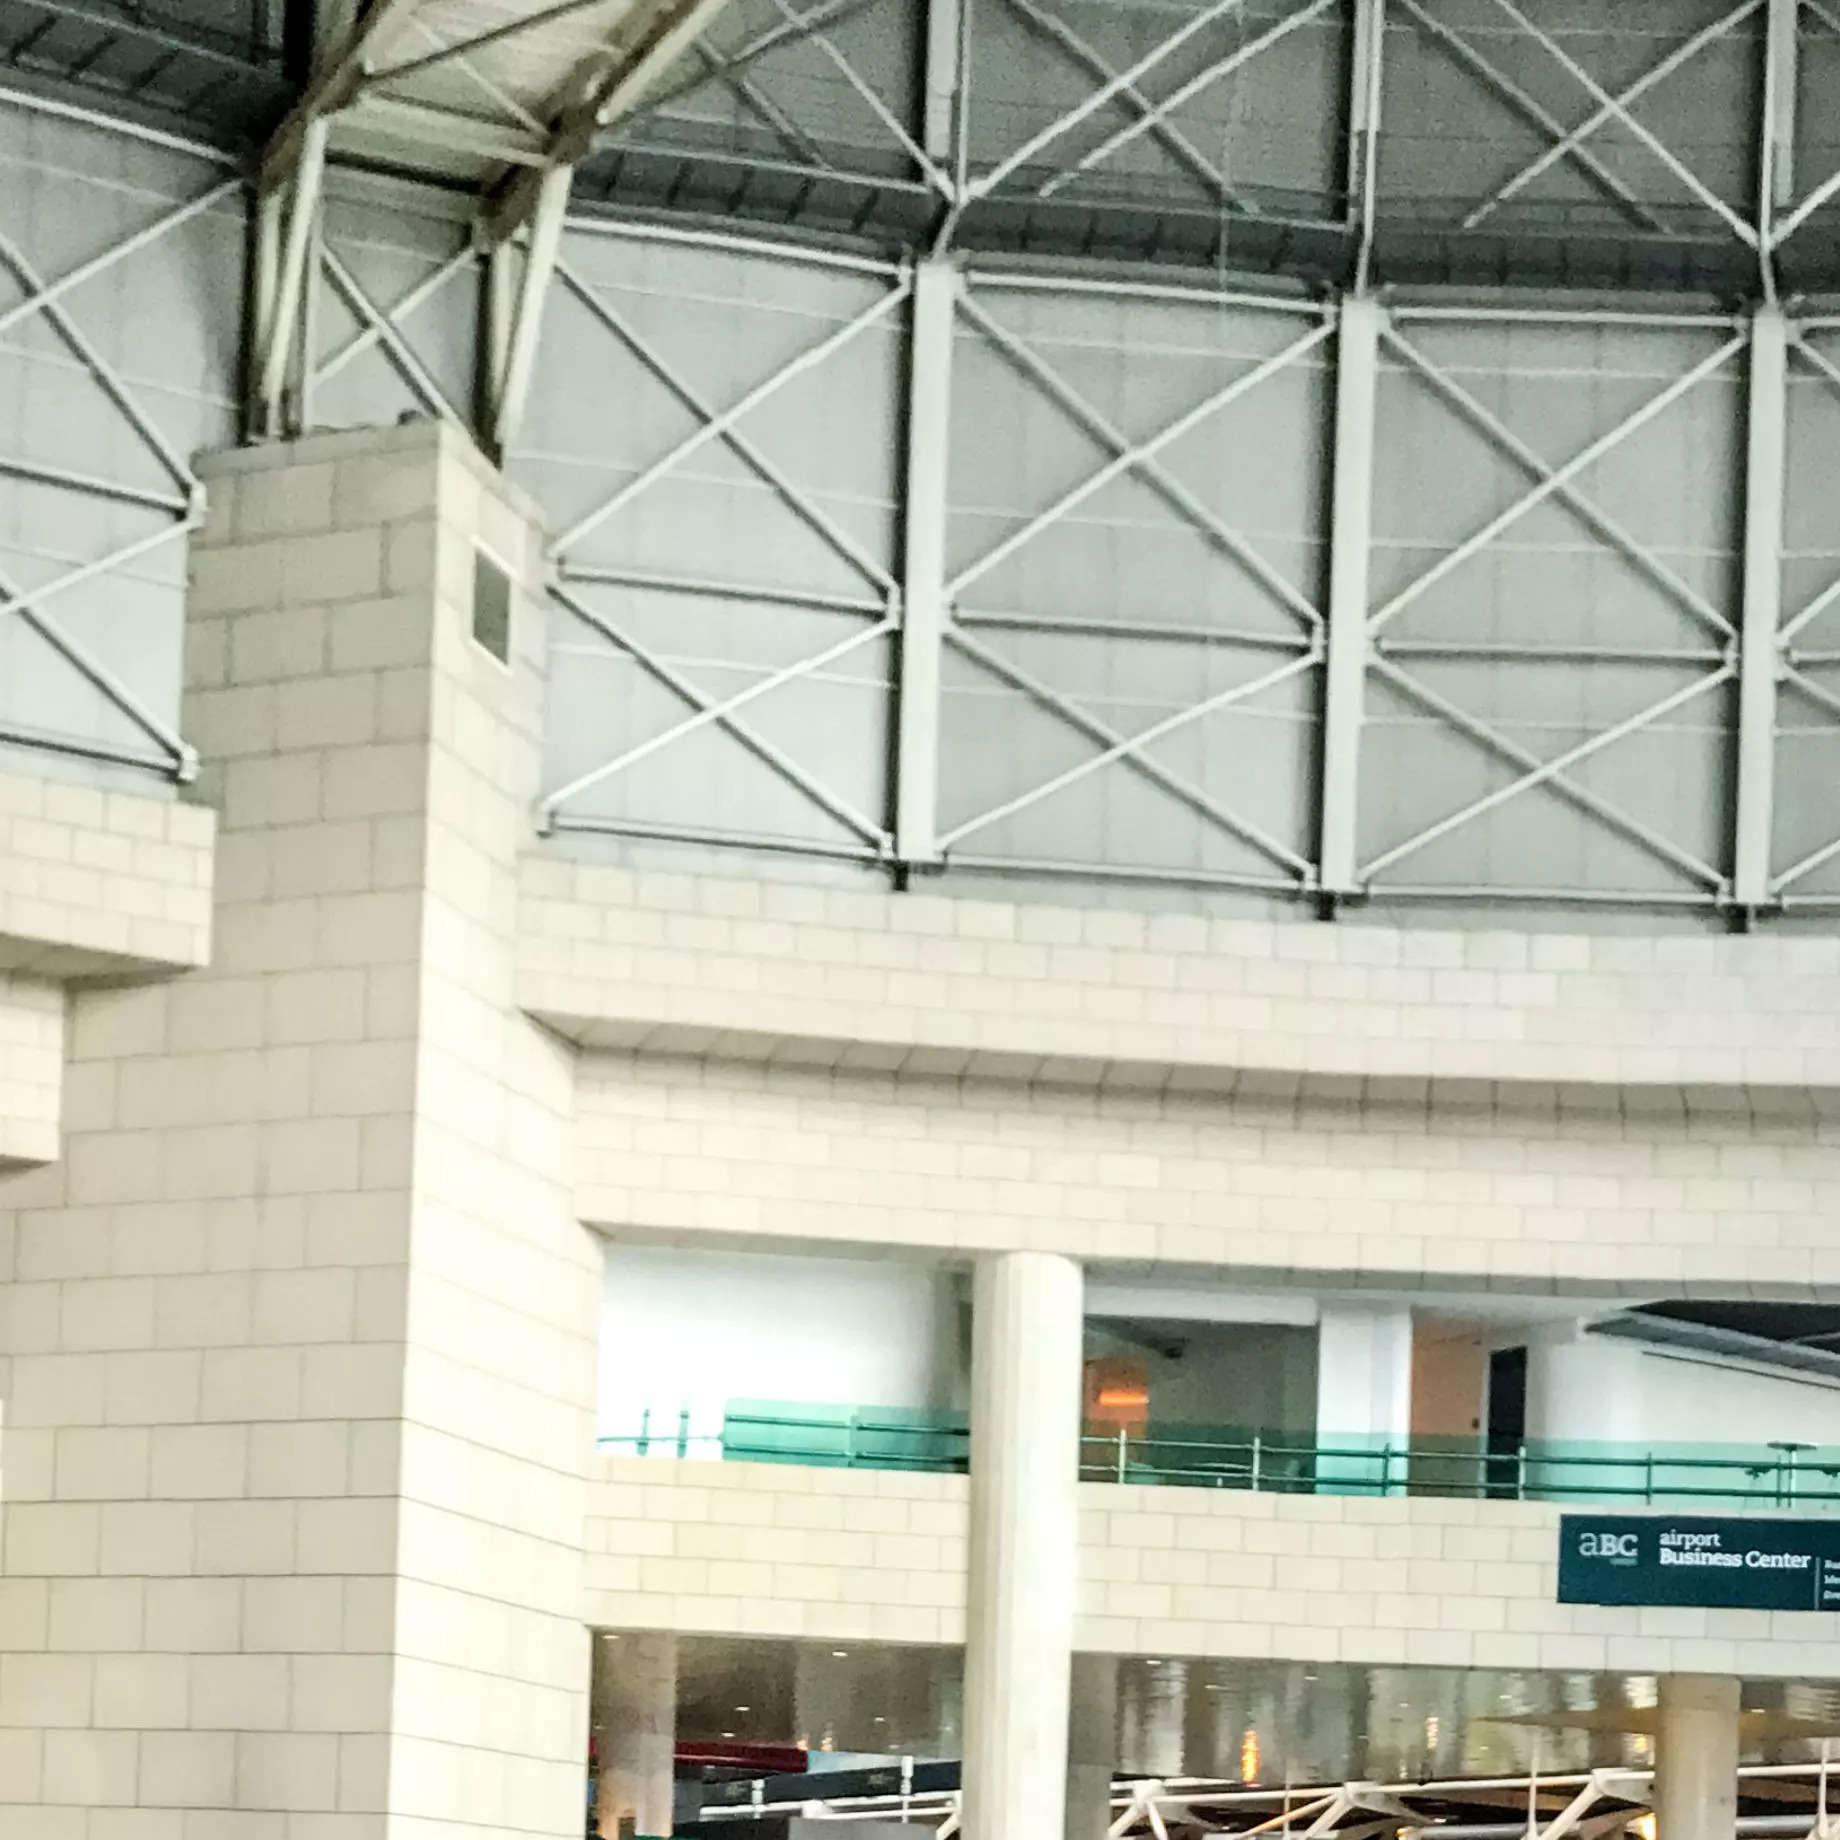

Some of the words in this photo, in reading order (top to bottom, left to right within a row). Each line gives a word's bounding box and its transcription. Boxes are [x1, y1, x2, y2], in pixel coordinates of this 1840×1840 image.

[1659, 1529, 1722, 1550] airport
[1659, 1547, 1743, 1568] Business
[1745, 1550, 1812, 1569] Center
